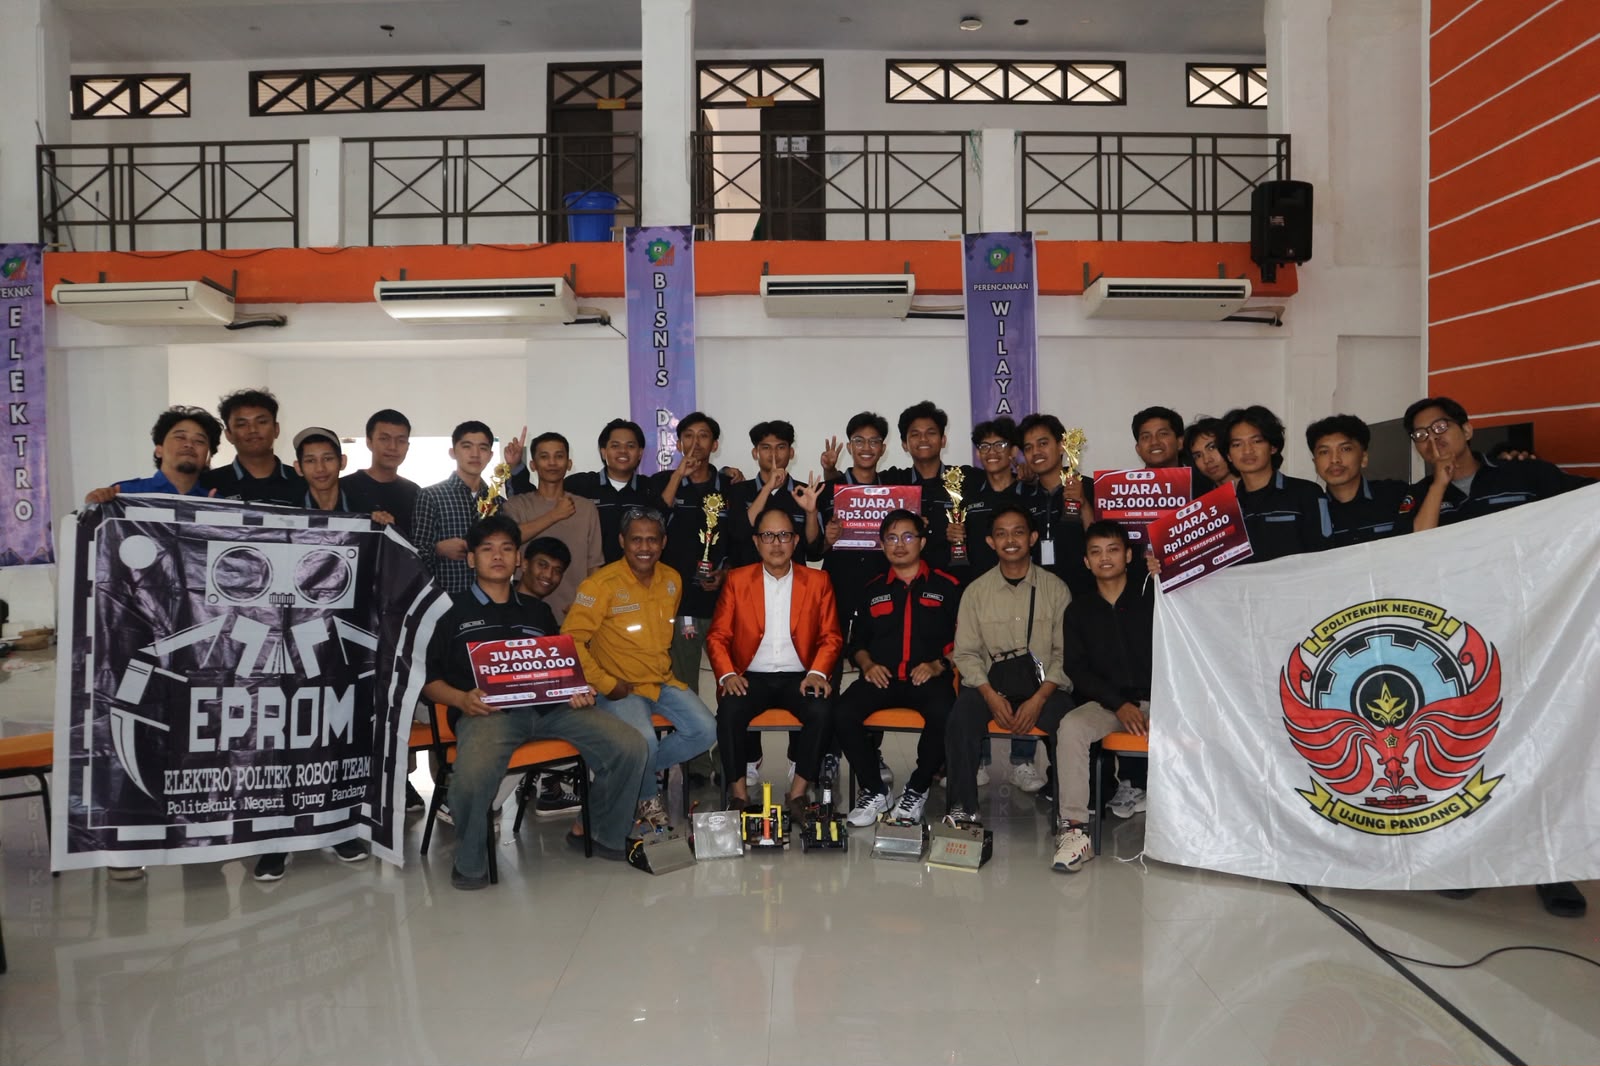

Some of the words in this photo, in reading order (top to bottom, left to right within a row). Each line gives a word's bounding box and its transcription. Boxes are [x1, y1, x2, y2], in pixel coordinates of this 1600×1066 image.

[973, 283, 1029, 291] PERENCANAAN
[654, 272, 669, 387] BISNIS
[991, 301, 1012, 414] WILAYA
[9, 307, 33, 521] ELEKTRO
[656, 409, 672, 471] DIG
[849, 498, 896, 509] JUARA
[898, 498, 904, 509] 1
[1098, 496, 1186, 511] Rp3.000.000
[1110, 483, 1162, 496] JUARA
[1165, 482, 1171, 494] 1
[837, 509, 916, 521] Rp3.000
[1168, 511, 1209, 538] JUARA
[1209, 505, 1218, 517] 3
[1163, 514, 1230, 554] Rp1.000.000
[1321, 603, 1388, 635] POLITEKNIK
[1392, 603, 1438, 621] NEGERI
[479, 657, 576, 676] Rp2.000.000
[490, 648, 546, 662] JUARA
[549, 646, 560, 657] 2
[189, 684, 356, 753] EPROM
[163, 766, 232, 795] ELEKTRO
[235, 765, 292, 791] POLTEK
[296, 760, 339, 787] ROBOT
[342, 756, 371, 781] TEAM
[167, 797, 236, 815] Politeknik
[244, 795, 285, 813] Negeri
[292, 792, 325, 810] Ujung
[331, 785, 367, 802] Pandang
[1338, 807, 1385, 830] UJUNG
[1390, 802, 1461, 830] PANDANG
